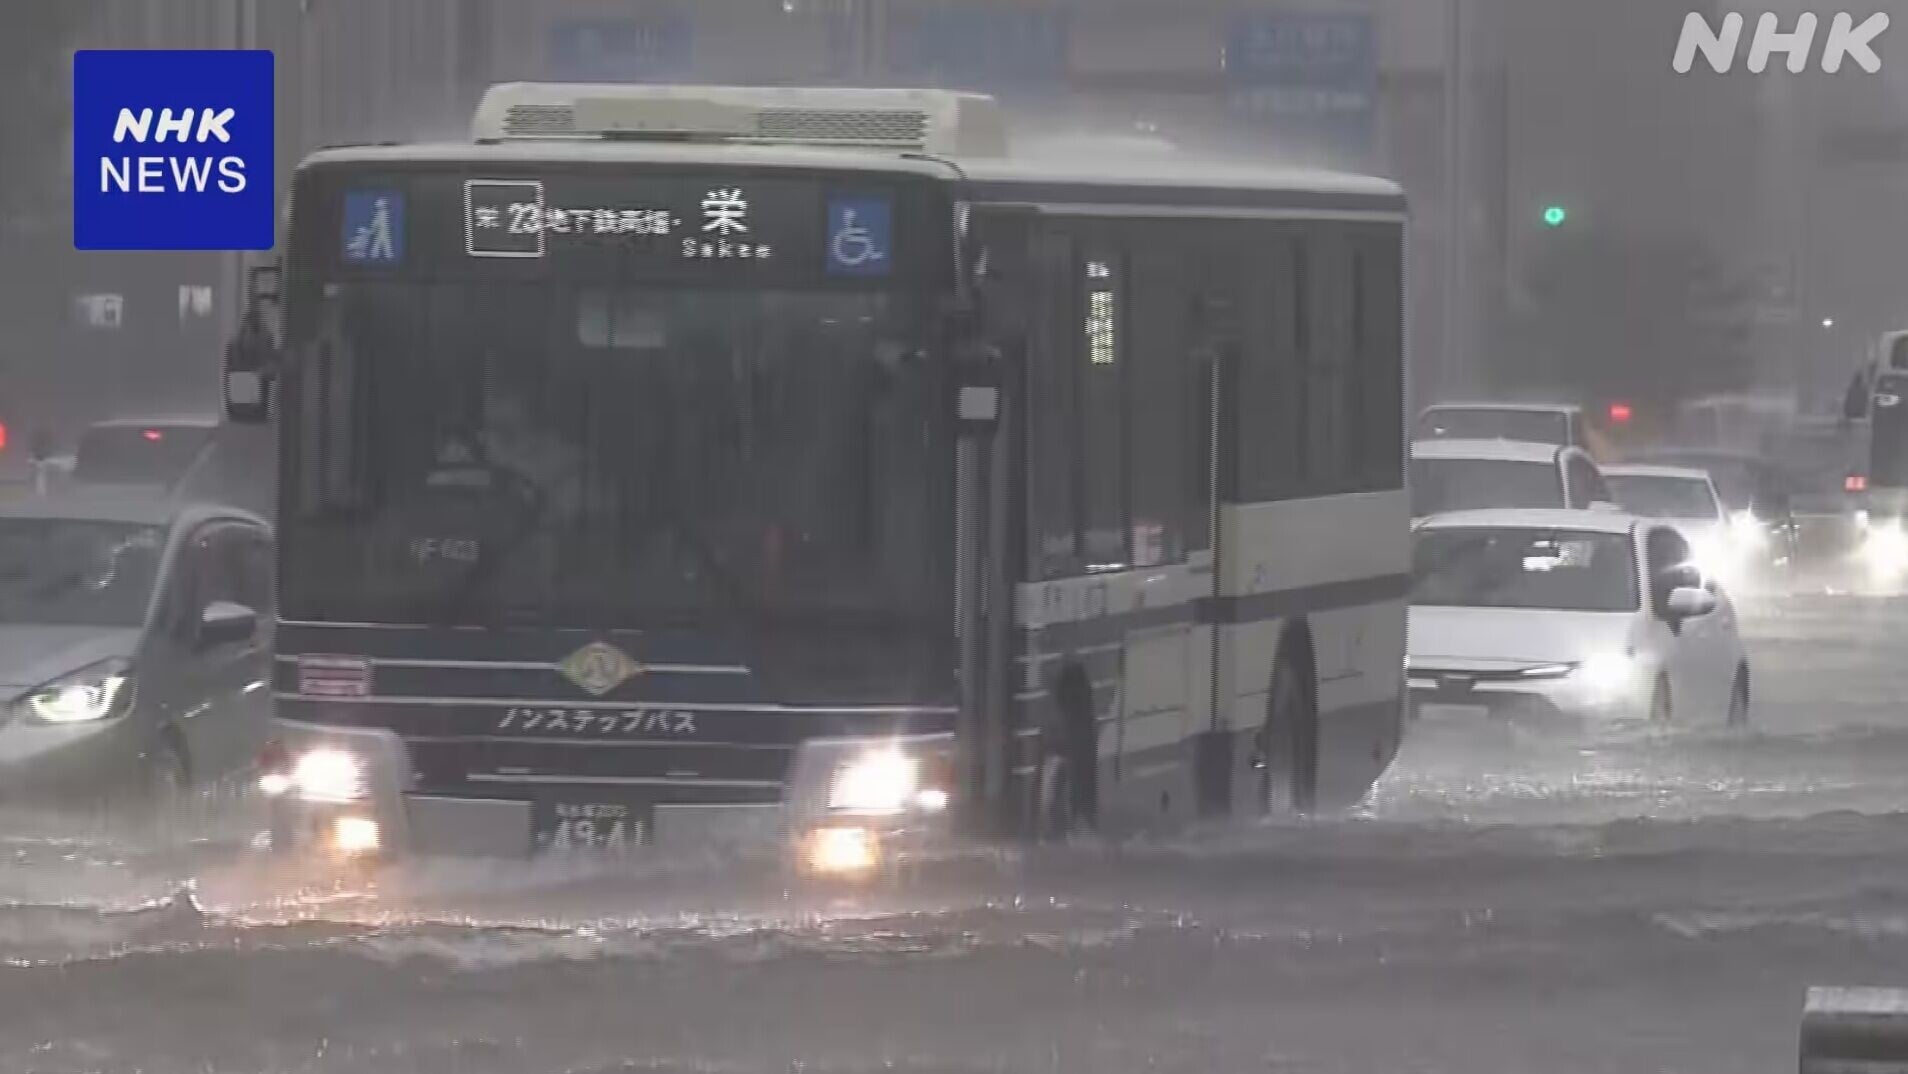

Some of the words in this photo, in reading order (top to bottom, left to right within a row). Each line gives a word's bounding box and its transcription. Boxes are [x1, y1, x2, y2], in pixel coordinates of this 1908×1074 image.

[507, 202, 541, 234] 23
[699, 186, 749, 236] 栄
[497, 707, 697, 734] ノンステップバス
